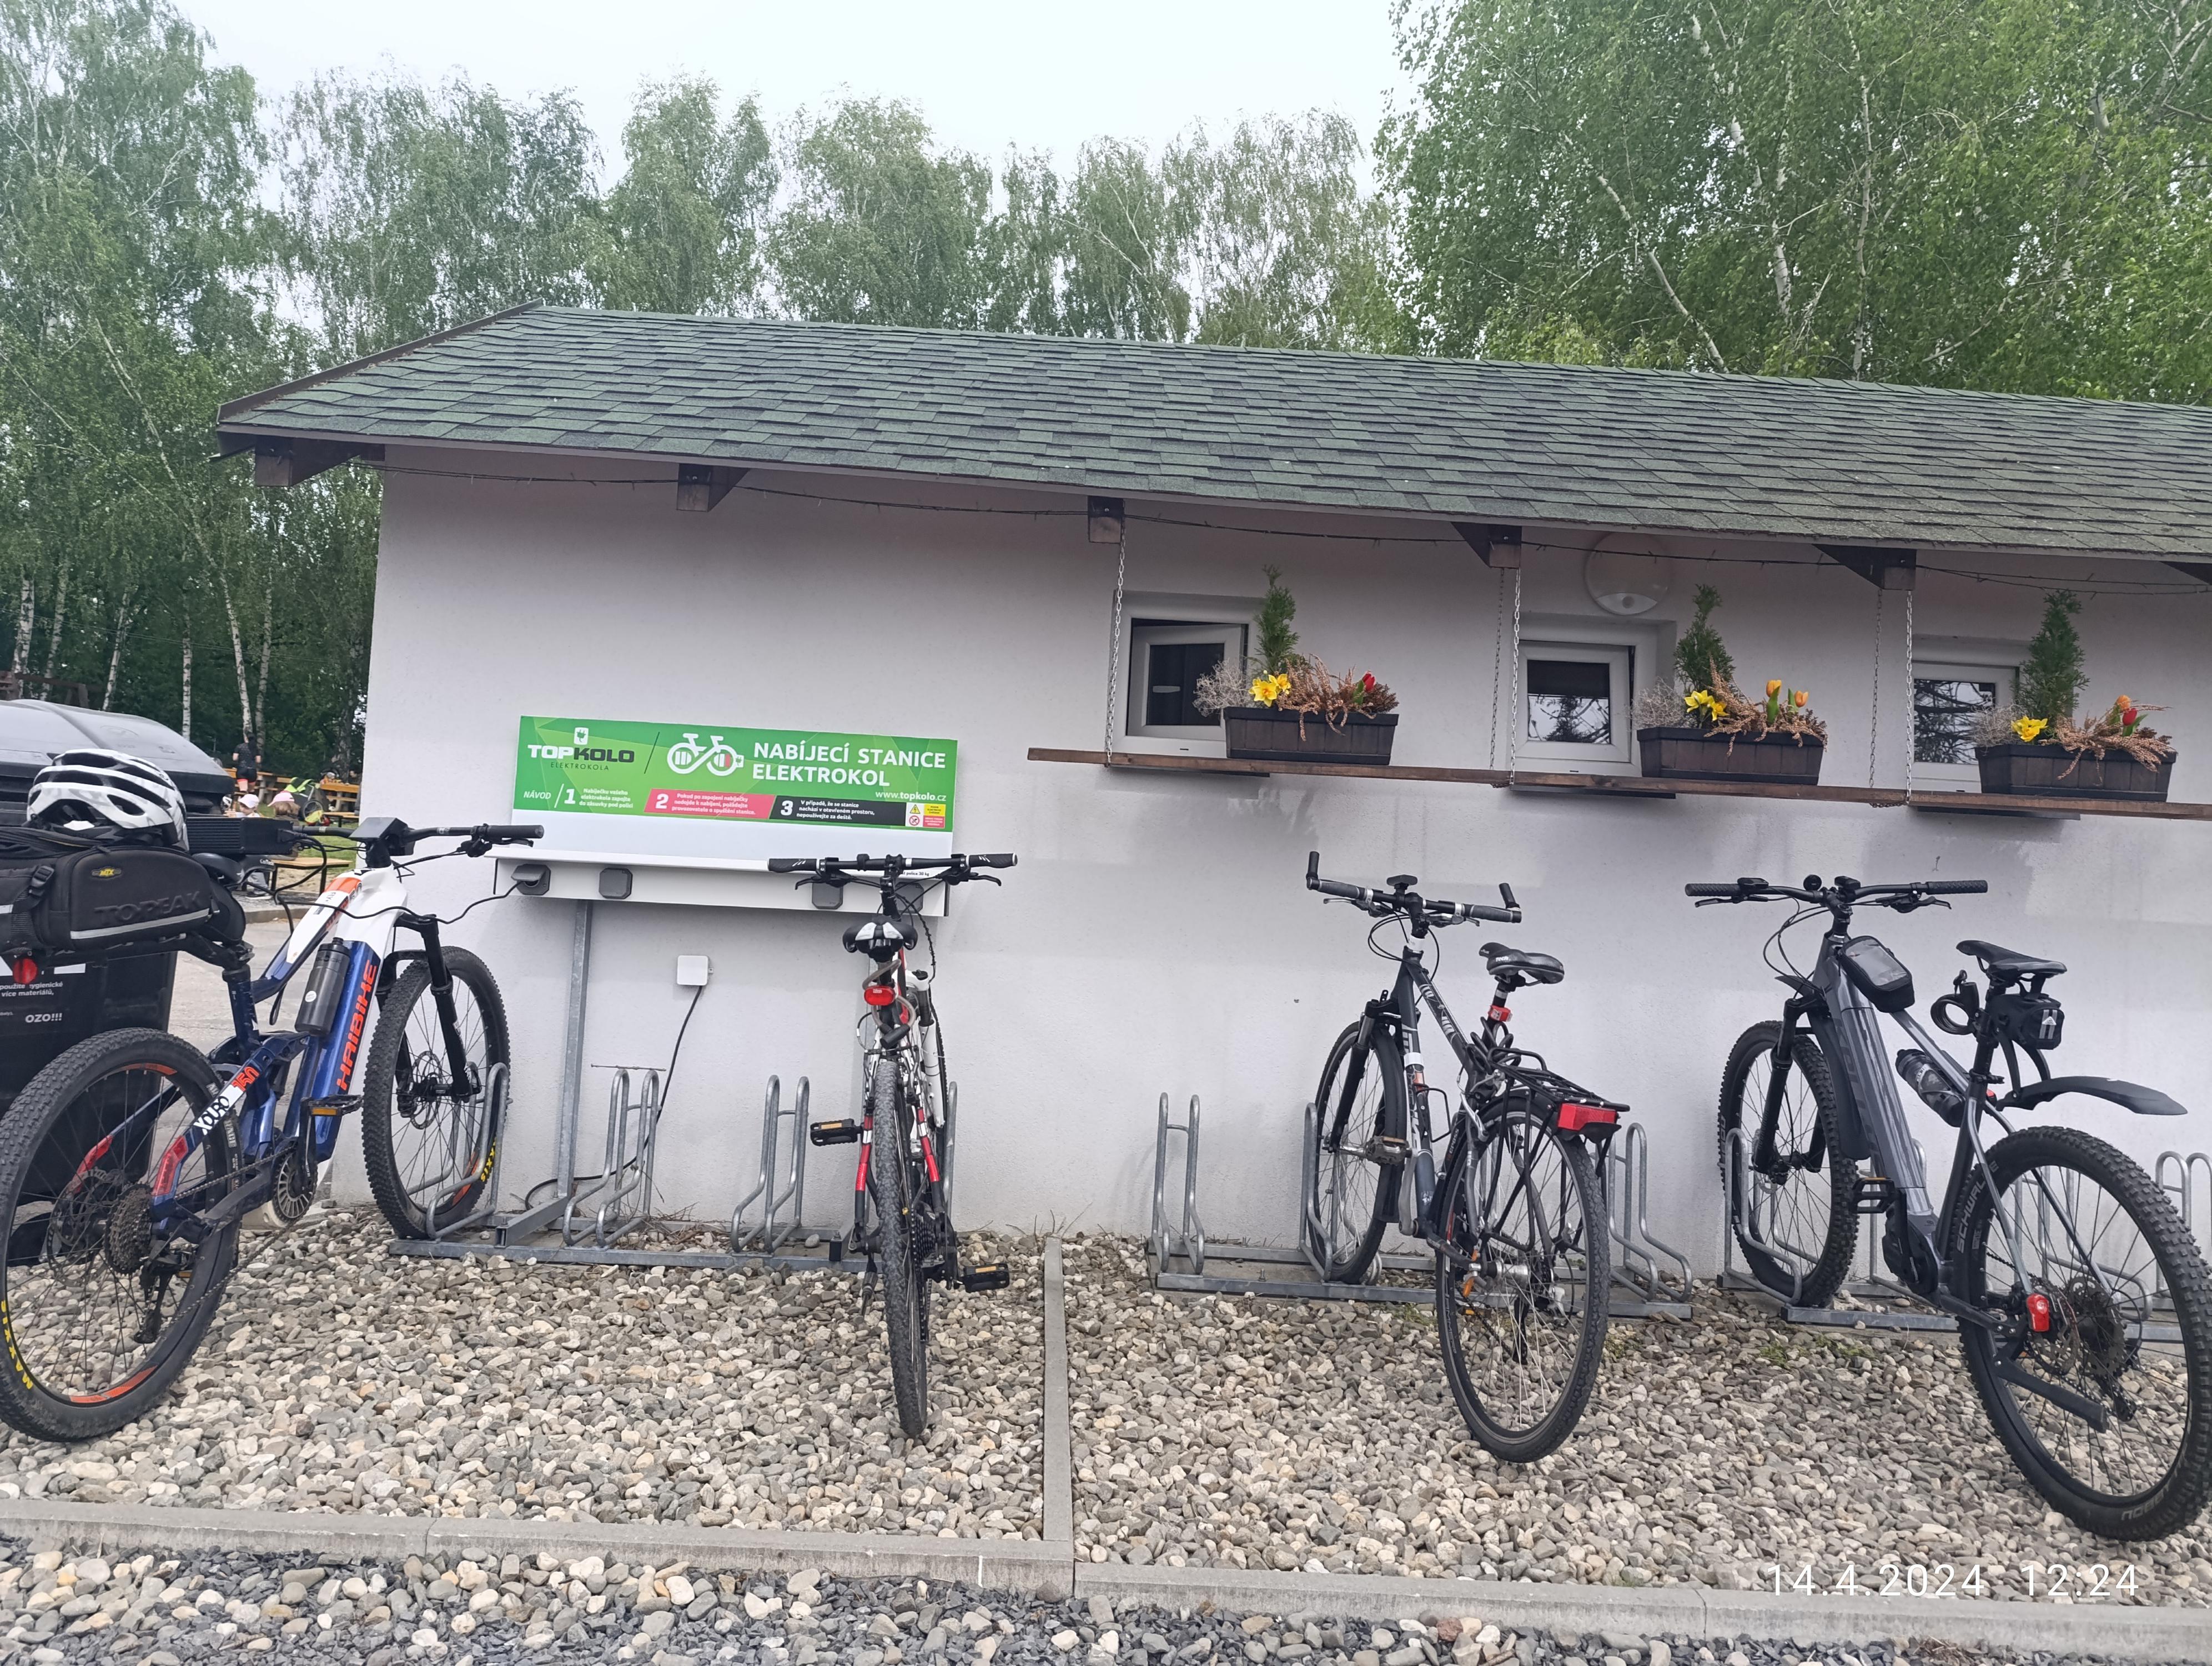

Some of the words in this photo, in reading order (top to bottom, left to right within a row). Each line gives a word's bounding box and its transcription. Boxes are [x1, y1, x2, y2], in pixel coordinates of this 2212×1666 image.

[527, 744, 635, 763] TOPKOLO
[753, 740, 849, 763] NABÍJECÍ
[858, 747, 946, 769] STANICE
[551, 761, 610, 771] ELEKTROKOLA
[752, 763, 891, 786] ELEKTROKOL
[523, 790, 551, 800] NÁVOD
[564, 789, 576, 805] 1
[655, 793, 669, 809] 2
[875, 791, 947, 802] www.topkolo.cz
[780, 800, 793, 816] 3
[93, 890, 200, 924] TOPEAK
[25, 1012, 63, 1023] OZO!!!
[336, 960, 377, 1091] HAIBIKE
[1957, 1160, 1999, 1254] SCHWALE
[1, 1299, 34, 1390] MAXXIS
